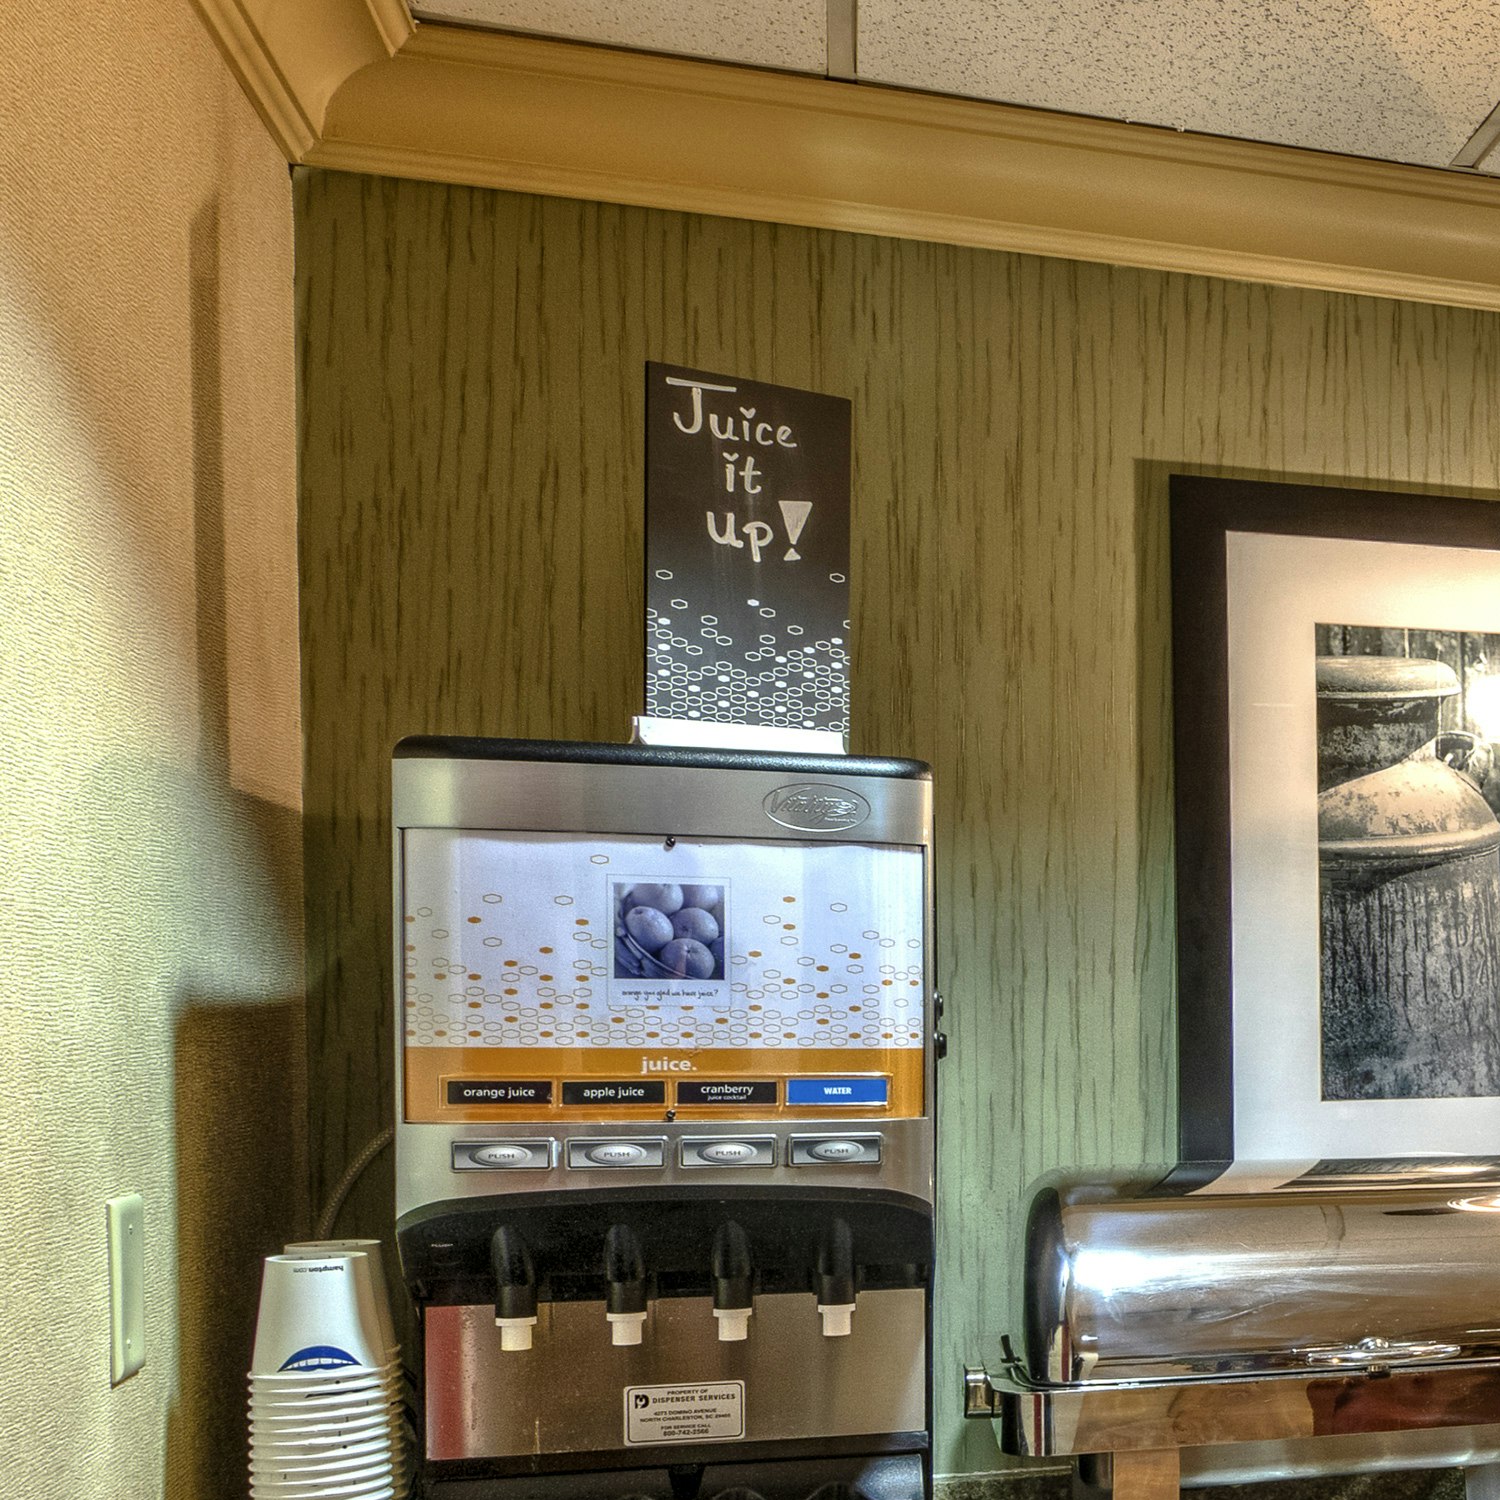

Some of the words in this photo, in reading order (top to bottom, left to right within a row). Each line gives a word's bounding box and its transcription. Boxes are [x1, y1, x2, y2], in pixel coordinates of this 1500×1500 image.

[666, 377, 797, 447] Juice
[723, 452, 762, 493] it
[706, 500, 813, 563] up!
[641, 1057, 697, 1075] juice.
[463, 1087, 505, 1099] orange
[507, 1087, 535, 1098] juice
[583, 1087, 615, 1099] apple
[617, 1086, 644, 1098] juice
[701, 1084, 753, 1096] cranberry
[824, 1087, 852, 1095] WATER
[652, 1395, 695, 1404] DISPENSER
[698, 1393, 736, 1401] SERVICES
